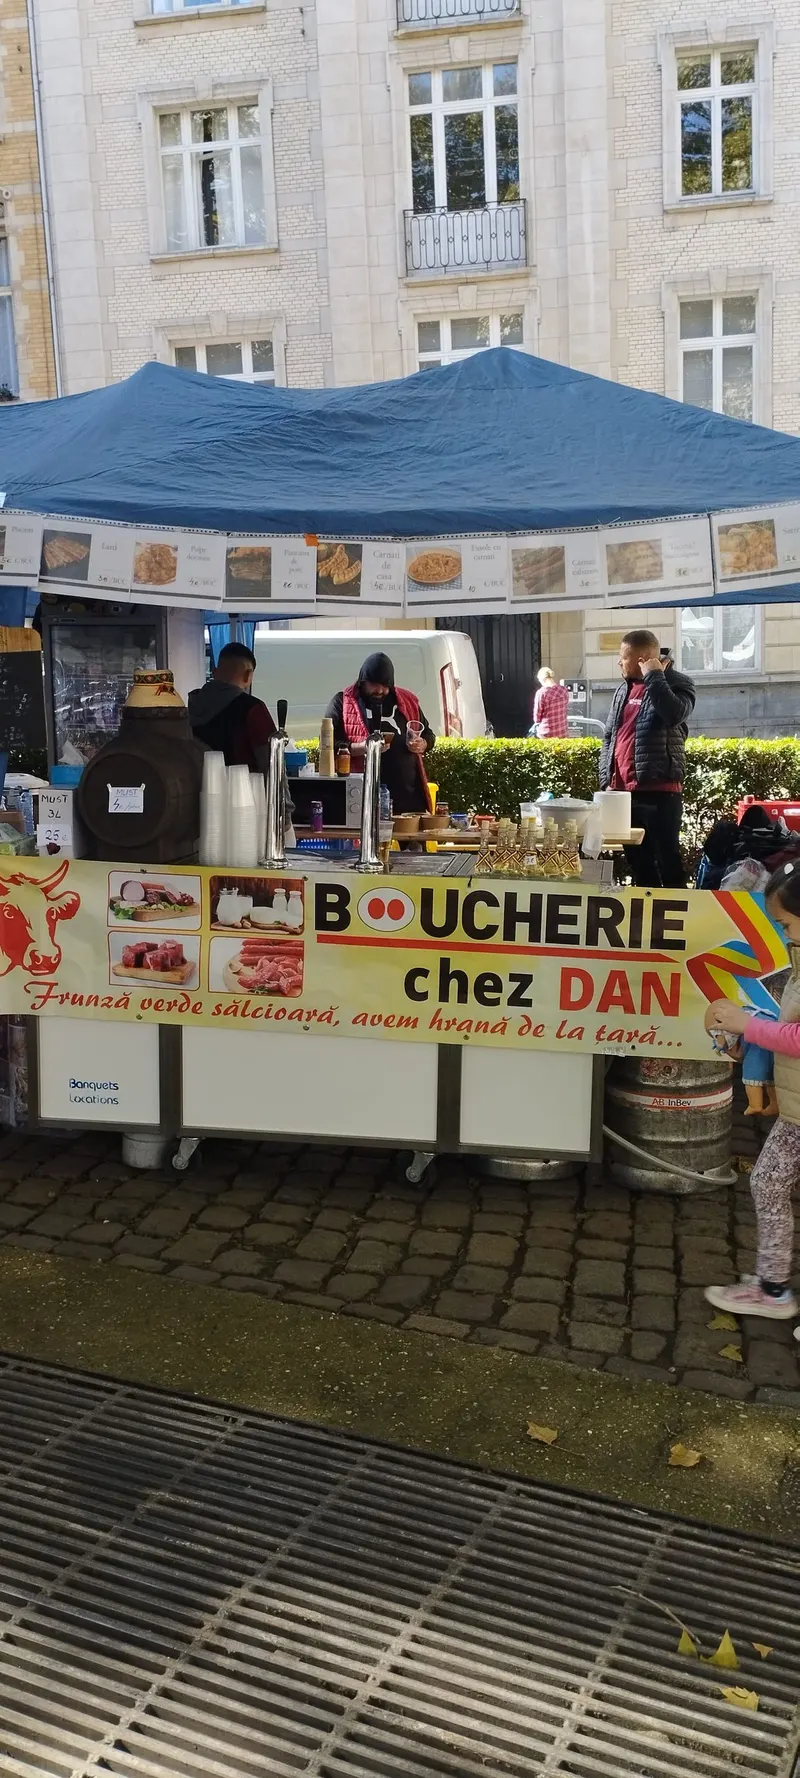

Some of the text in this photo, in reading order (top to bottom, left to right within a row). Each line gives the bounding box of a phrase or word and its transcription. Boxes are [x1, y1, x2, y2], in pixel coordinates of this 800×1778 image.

[372, 549, 400, 559] Carnati
[381, 561, 391, 569] de
[41, 794, 68, 803] MUST
[47, 809, 61, 819] 3L
[403, 957, 681, 1017] chez DAN
[24, 980, 132, 1010] Frunză
[139, 992, 203, 1015] verde
[210, 1000, 340, 1027] sălcioară,
[351, 1012, 419, 1029] avem
[428, 1007, 513, 1036] hrană
[517, 1014, 545, 1039] de
[555, 1019, 585, 1040] la
[69, 1078, 119, 1091] Banquets
[69, 1093, 119, 1105] Locations
[652, 1098, 665, 1106] AB
